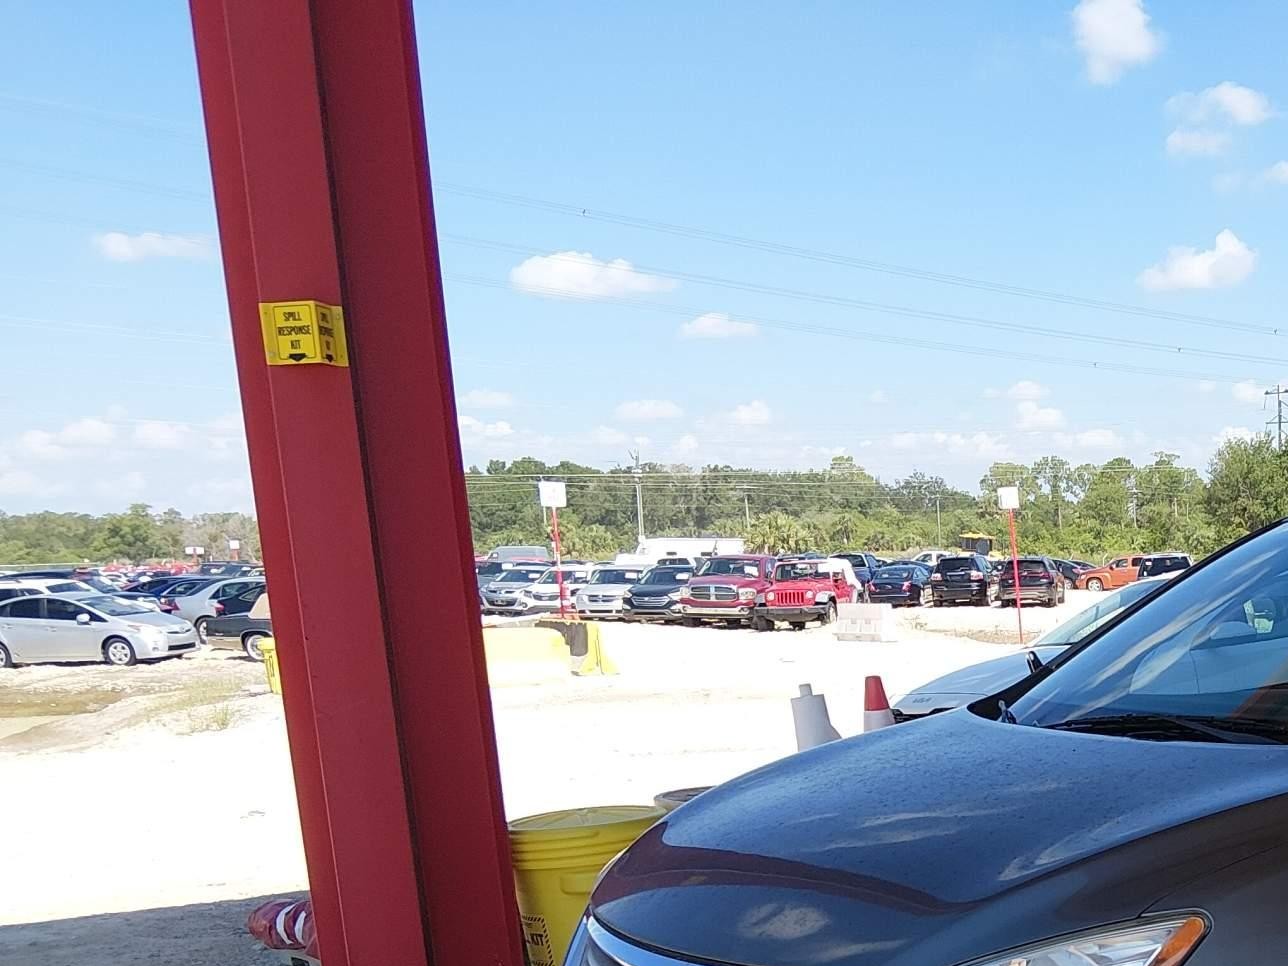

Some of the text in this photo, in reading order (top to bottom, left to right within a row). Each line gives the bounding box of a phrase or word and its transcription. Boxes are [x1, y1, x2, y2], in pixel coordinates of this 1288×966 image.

[283, 311, 302, 321] SPILL
[277, 325, 311, 336] RESPONSE
[290, 340, 301, 349] KIT
[529, 932, 544, 946] KIT
